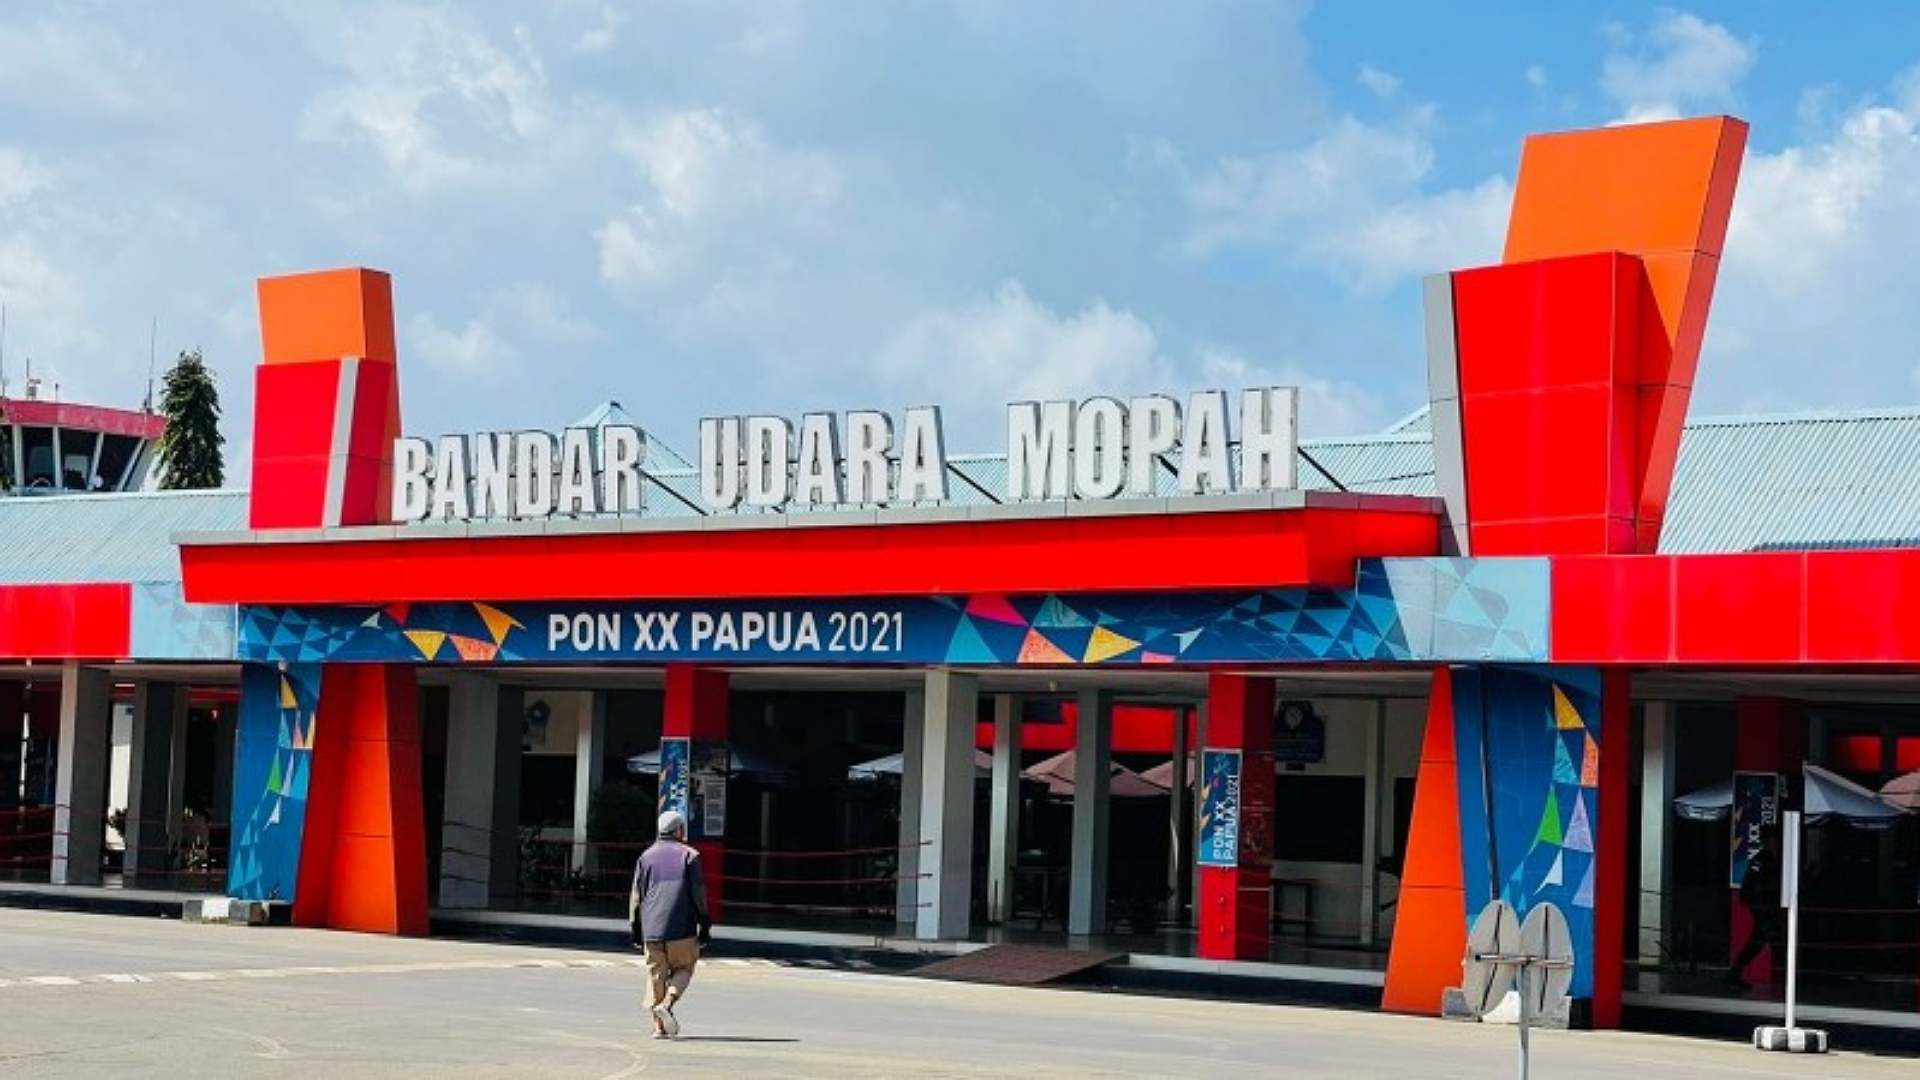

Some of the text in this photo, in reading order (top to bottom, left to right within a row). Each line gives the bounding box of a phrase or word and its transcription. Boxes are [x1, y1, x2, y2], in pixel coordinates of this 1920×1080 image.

[392, 386, 1299, 522] BANDAR UDARA MOPAH
[548, 611, 904, 652] PON XX PAPUA 2021
[1213, 800, 1226, 860] PON XX
[1223, 775, 1239, 860] PAPUA 2021
